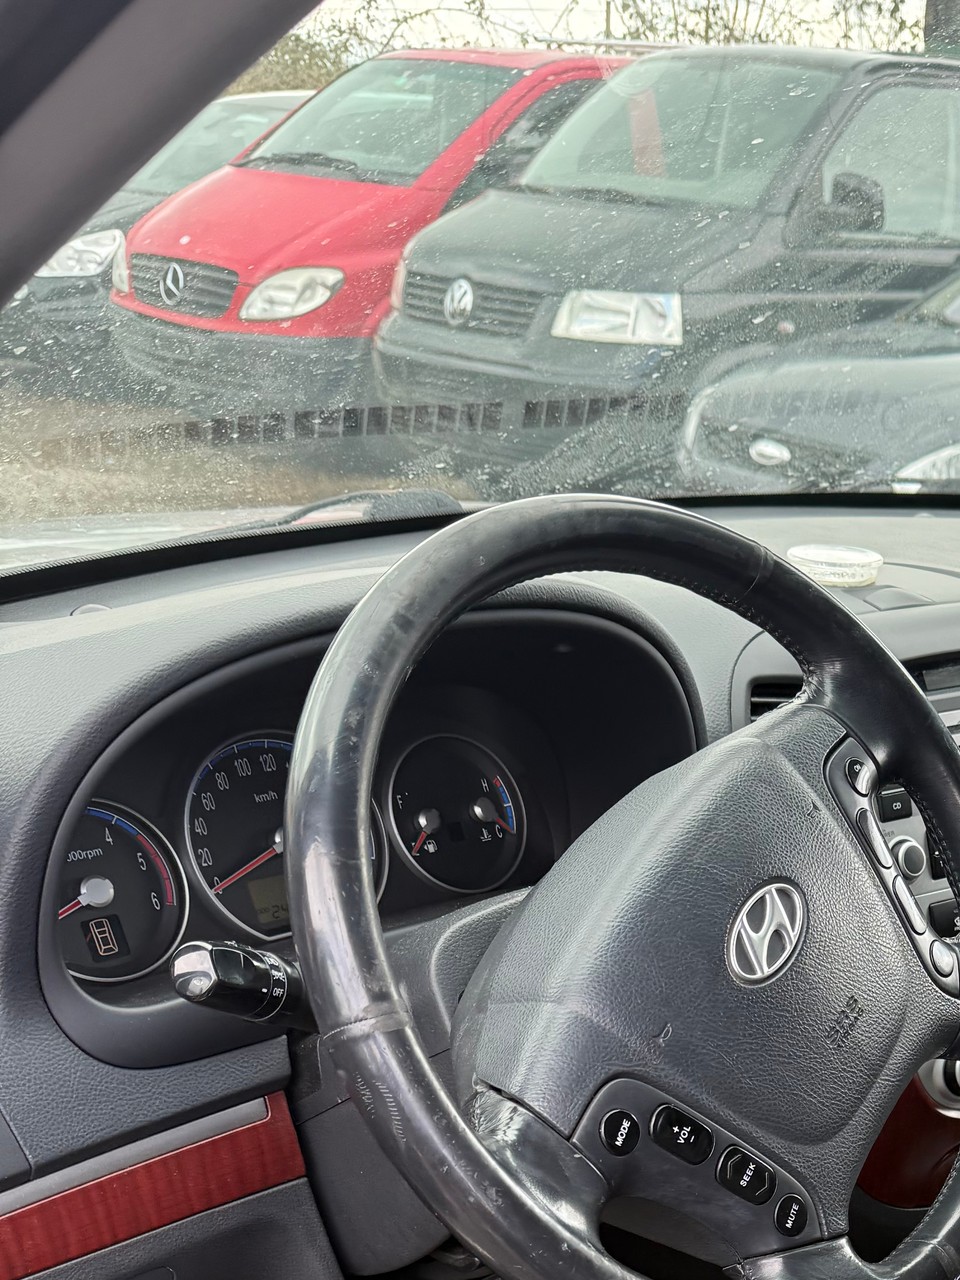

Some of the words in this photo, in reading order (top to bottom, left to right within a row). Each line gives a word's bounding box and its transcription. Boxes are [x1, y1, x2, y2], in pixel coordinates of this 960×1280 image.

[234, 757, 252, 777] 100
[260, 753, 277, 772] 120
[215, 771, 229, 791] 80
[480, 778, 490, 793] H
[201, 792, 216, 811] 60
[254, 790, 278, 803] km/h
[105, 827, 113, 845] 4
[194, 817, 208, 836] 40
[495, 824, 503, 839] C
[137, 852, 147, 871] 5
[197, 848, 213, 867] 20
[151, 891, 161, 911] 6
[272, 987, 285, 998] OFF
[614, 1118, 632, 1147] MODE
[676, 1125, 692, 1144] VOL
[739, 1161, 757, 1187] SEEK
[785, 1202, 800, 1229] MUTE
